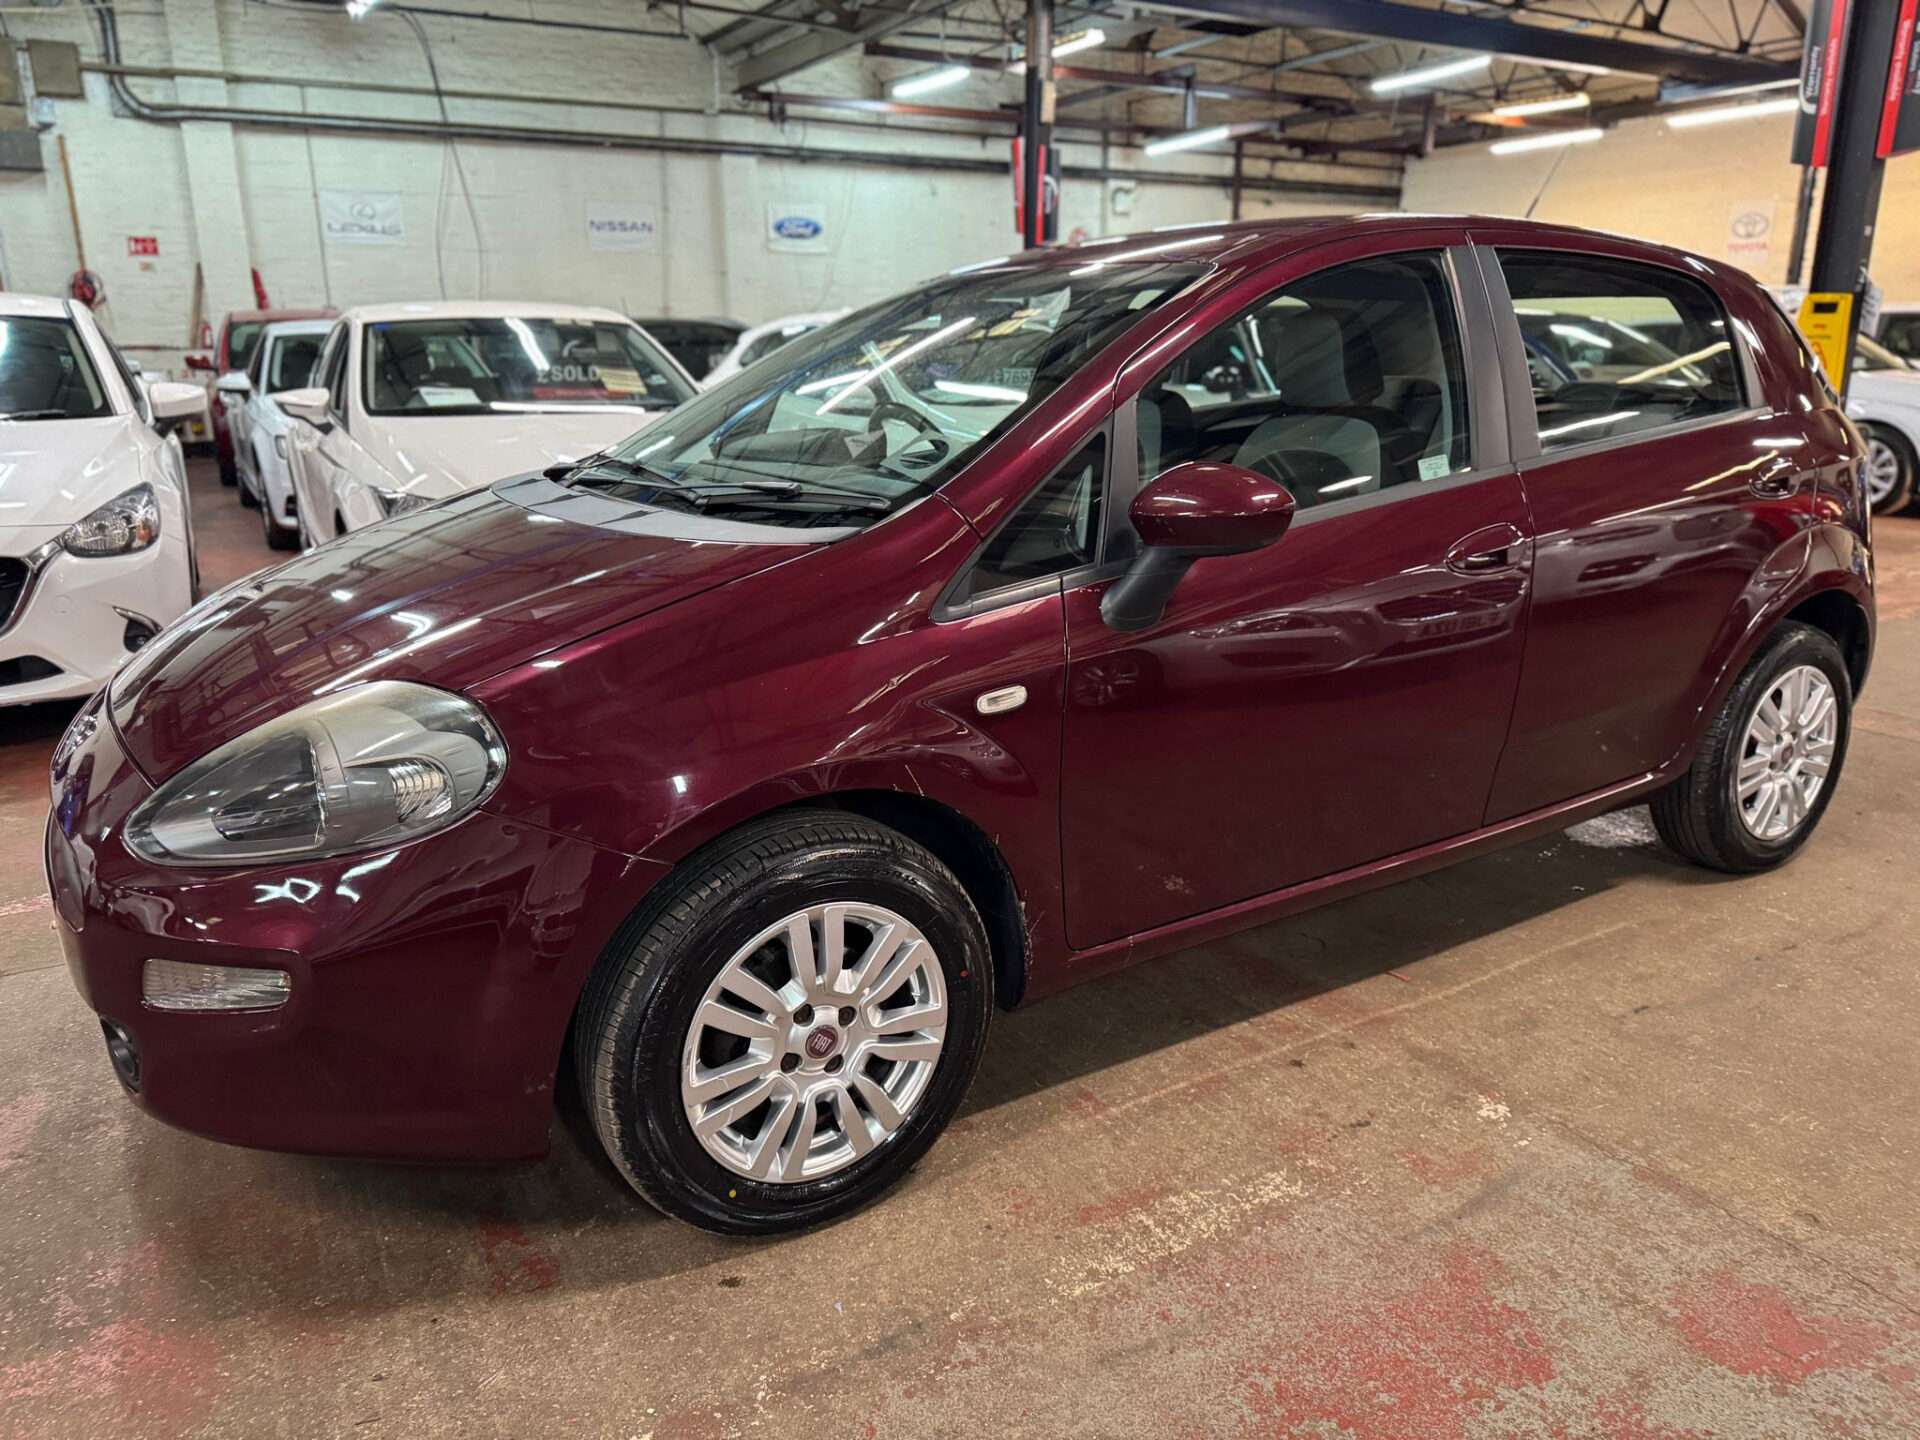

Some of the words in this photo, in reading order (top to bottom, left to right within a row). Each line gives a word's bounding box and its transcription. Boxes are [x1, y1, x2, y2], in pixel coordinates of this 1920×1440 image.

[326, 222, 402, 236] LEXUS
[590, 219, 654, 233] NISSAN
[811, 1033, 833, 1053] FIAT
